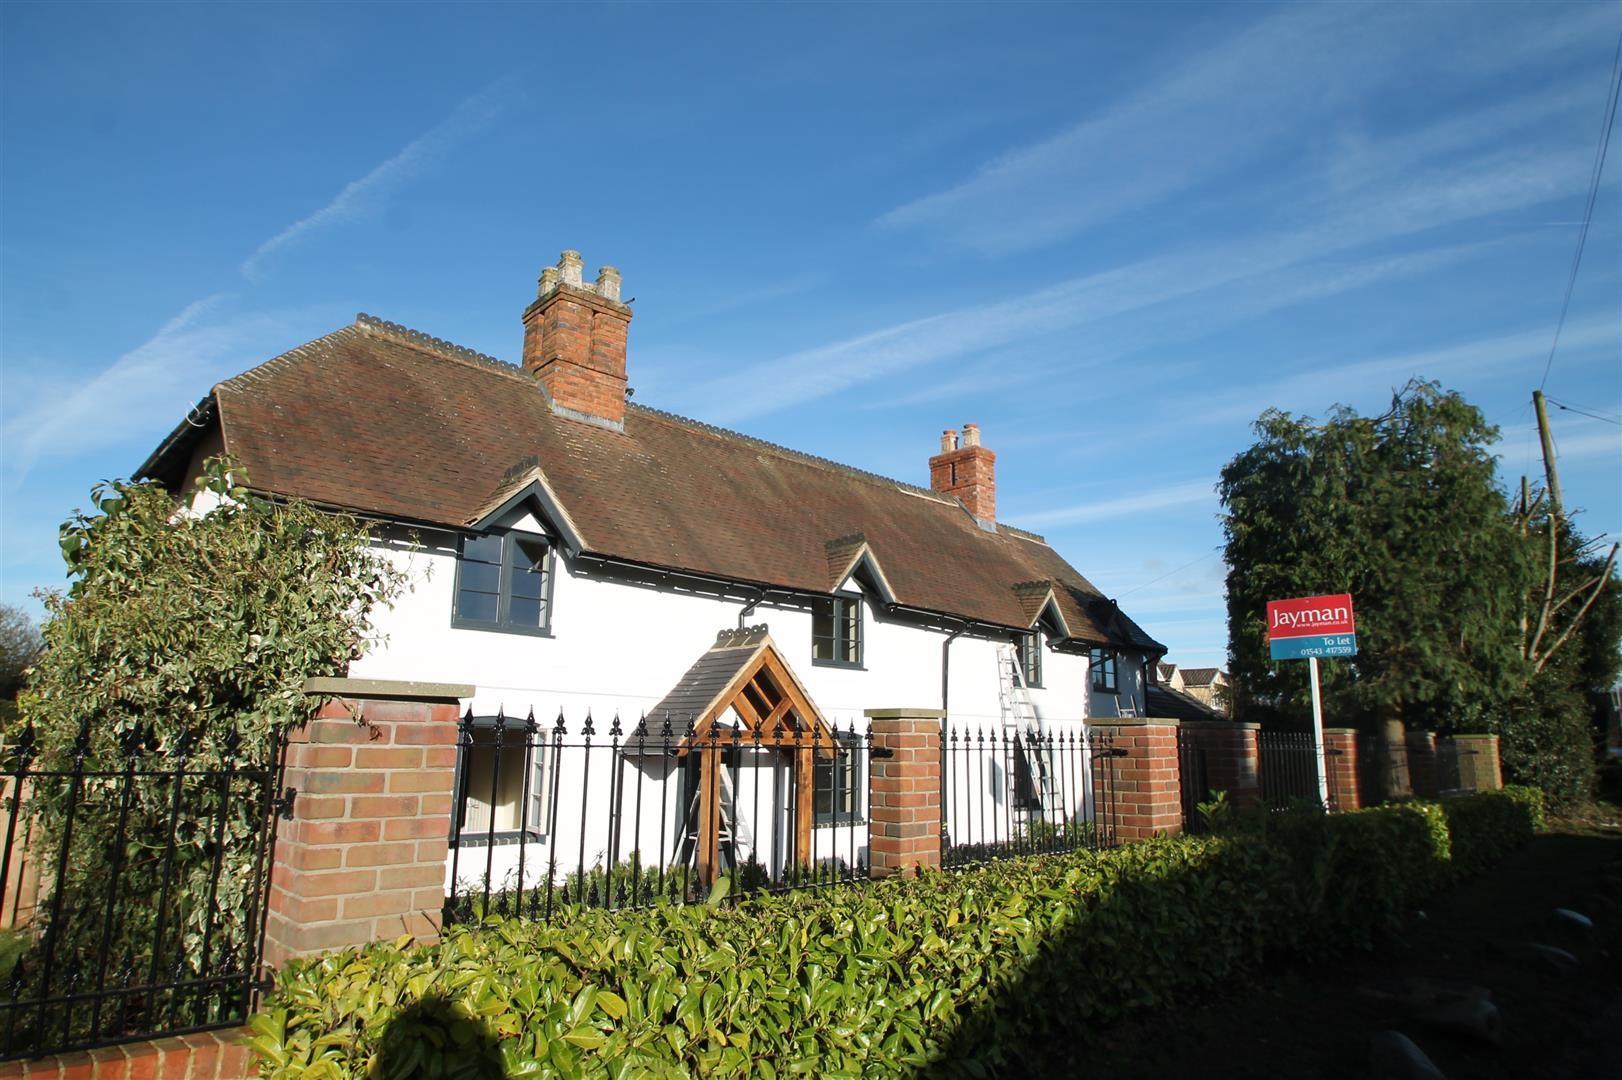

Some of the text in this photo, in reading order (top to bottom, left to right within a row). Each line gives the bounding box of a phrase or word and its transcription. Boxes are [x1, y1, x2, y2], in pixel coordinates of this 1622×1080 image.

[1272, 607, 1348, 628] Jayman
[1322, 637, 1350, 646] To Let
[1300, 648, 1322, 656] 01543
